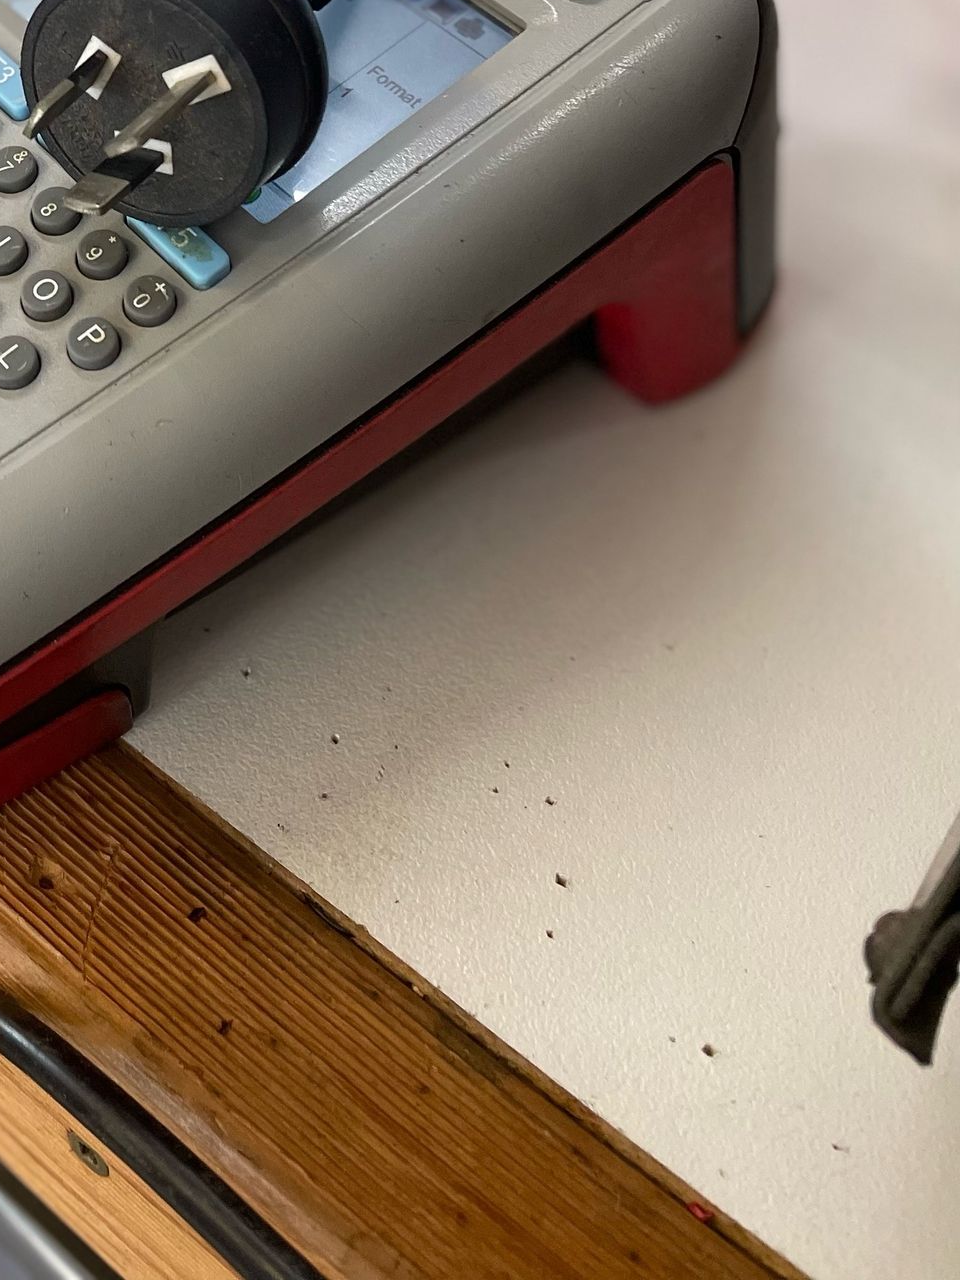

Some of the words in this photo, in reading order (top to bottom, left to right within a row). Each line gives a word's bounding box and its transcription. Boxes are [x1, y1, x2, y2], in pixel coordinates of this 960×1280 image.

[367, 65, 423, 109] Format
[40, 203, 58, 217] 8
[85, 247, 103, 261] 9
[32, 278, 59, 301] O
[76, 323, 106, 343] P
